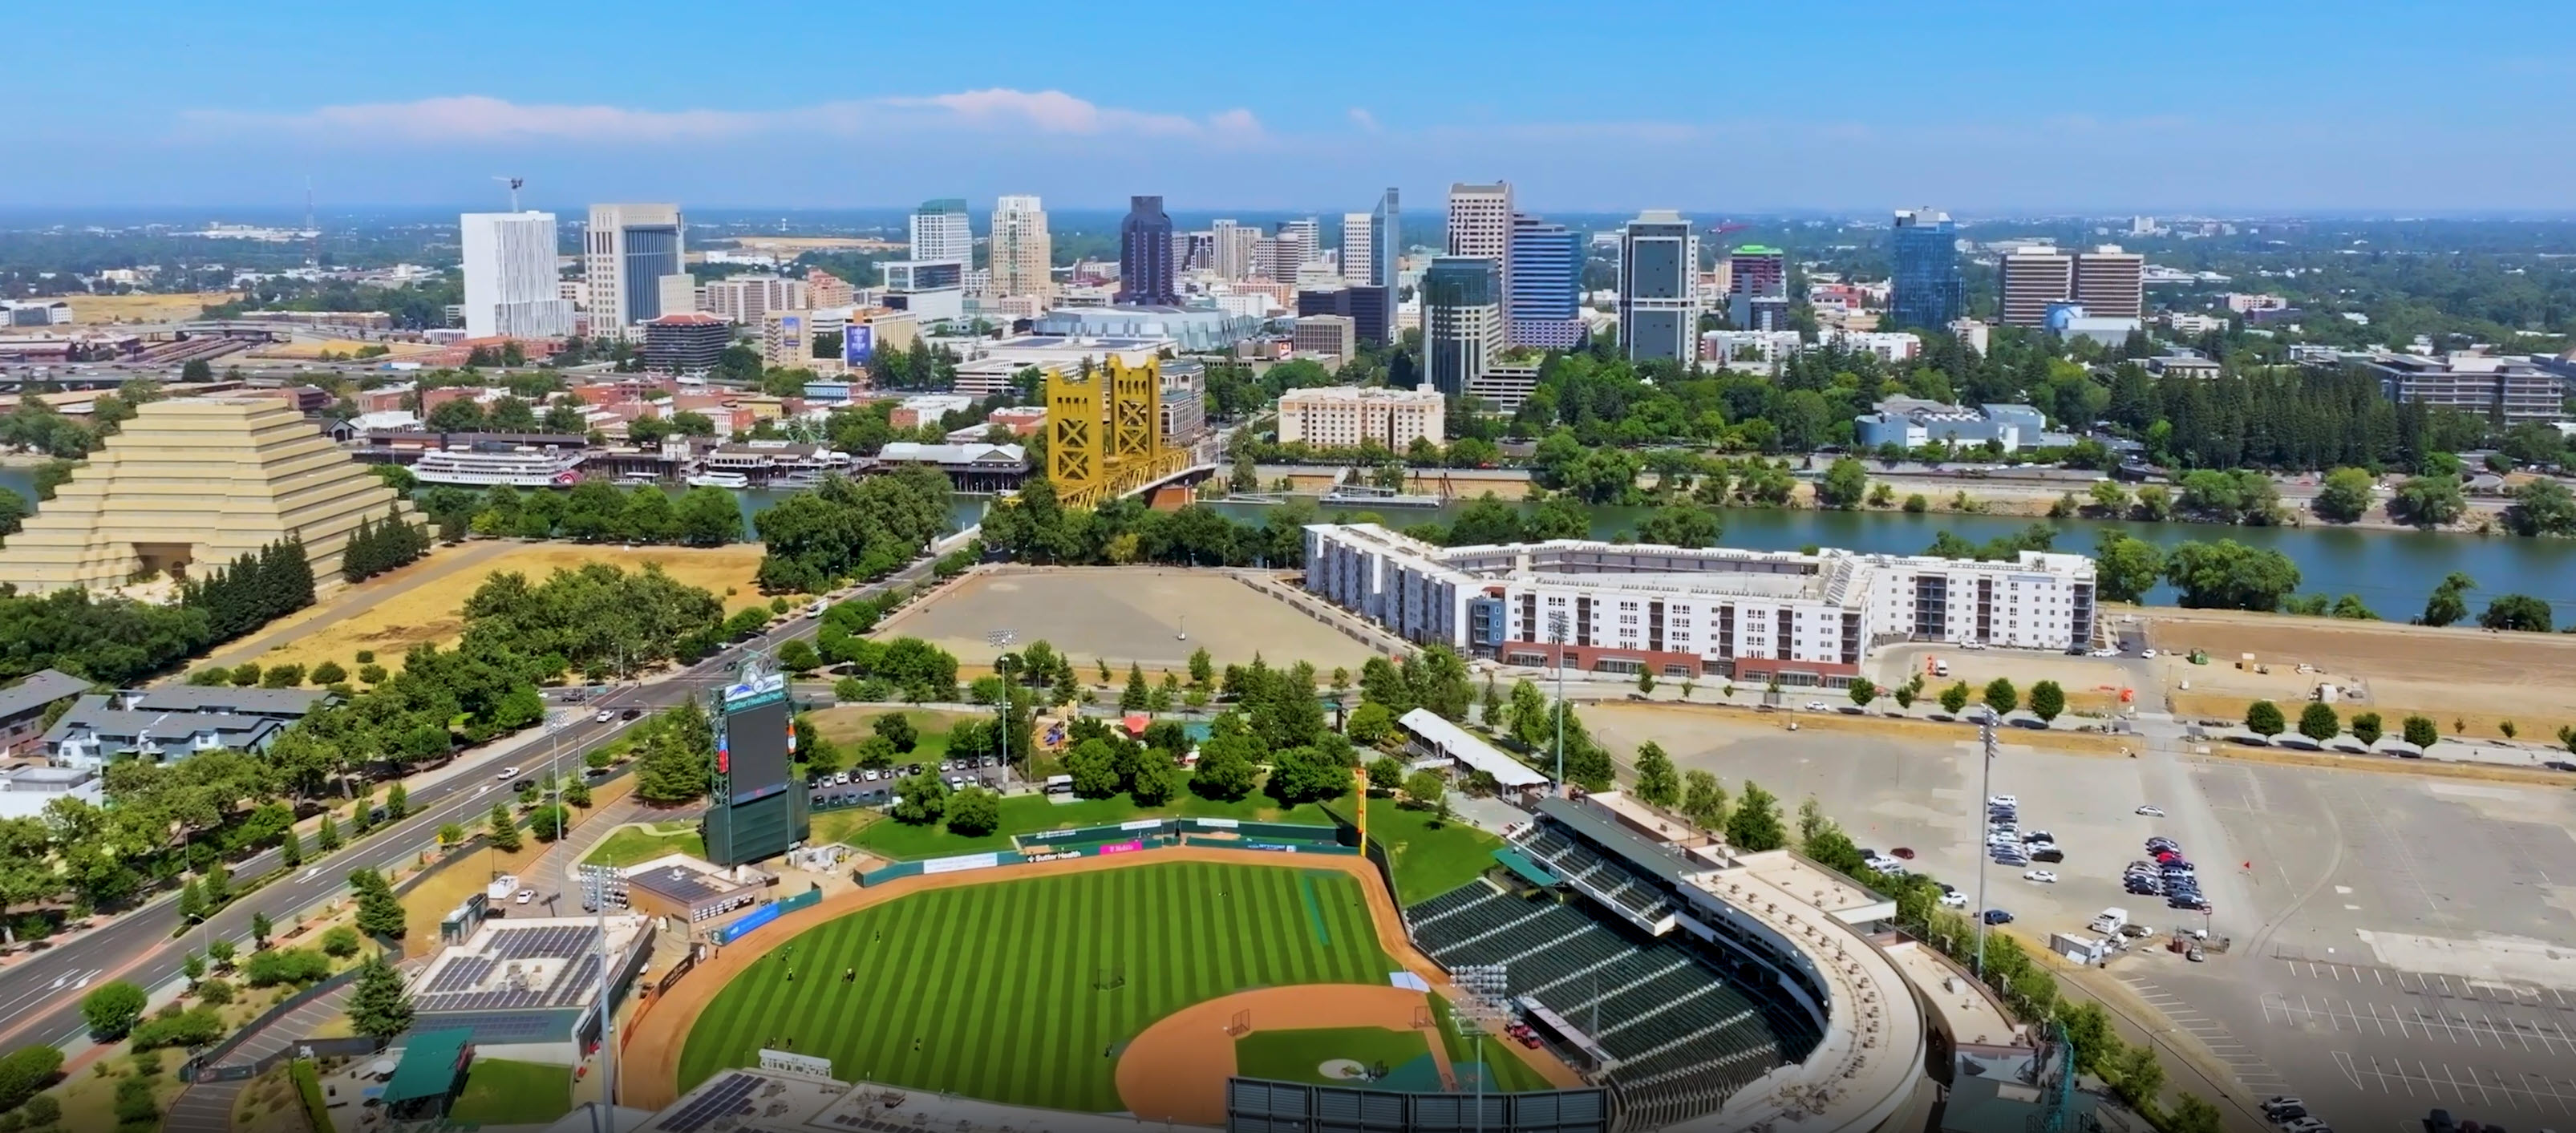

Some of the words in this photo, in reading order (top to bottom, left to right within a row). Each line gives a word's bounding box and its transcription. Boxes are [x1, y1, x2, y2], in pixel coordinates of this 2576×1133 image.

[727, 702, 747, 711] Sutter
[747, 695, 768, 706] Health
[1035, 854, 1058, 862] Sutter
[1059, 850, 1081, 860] Health
